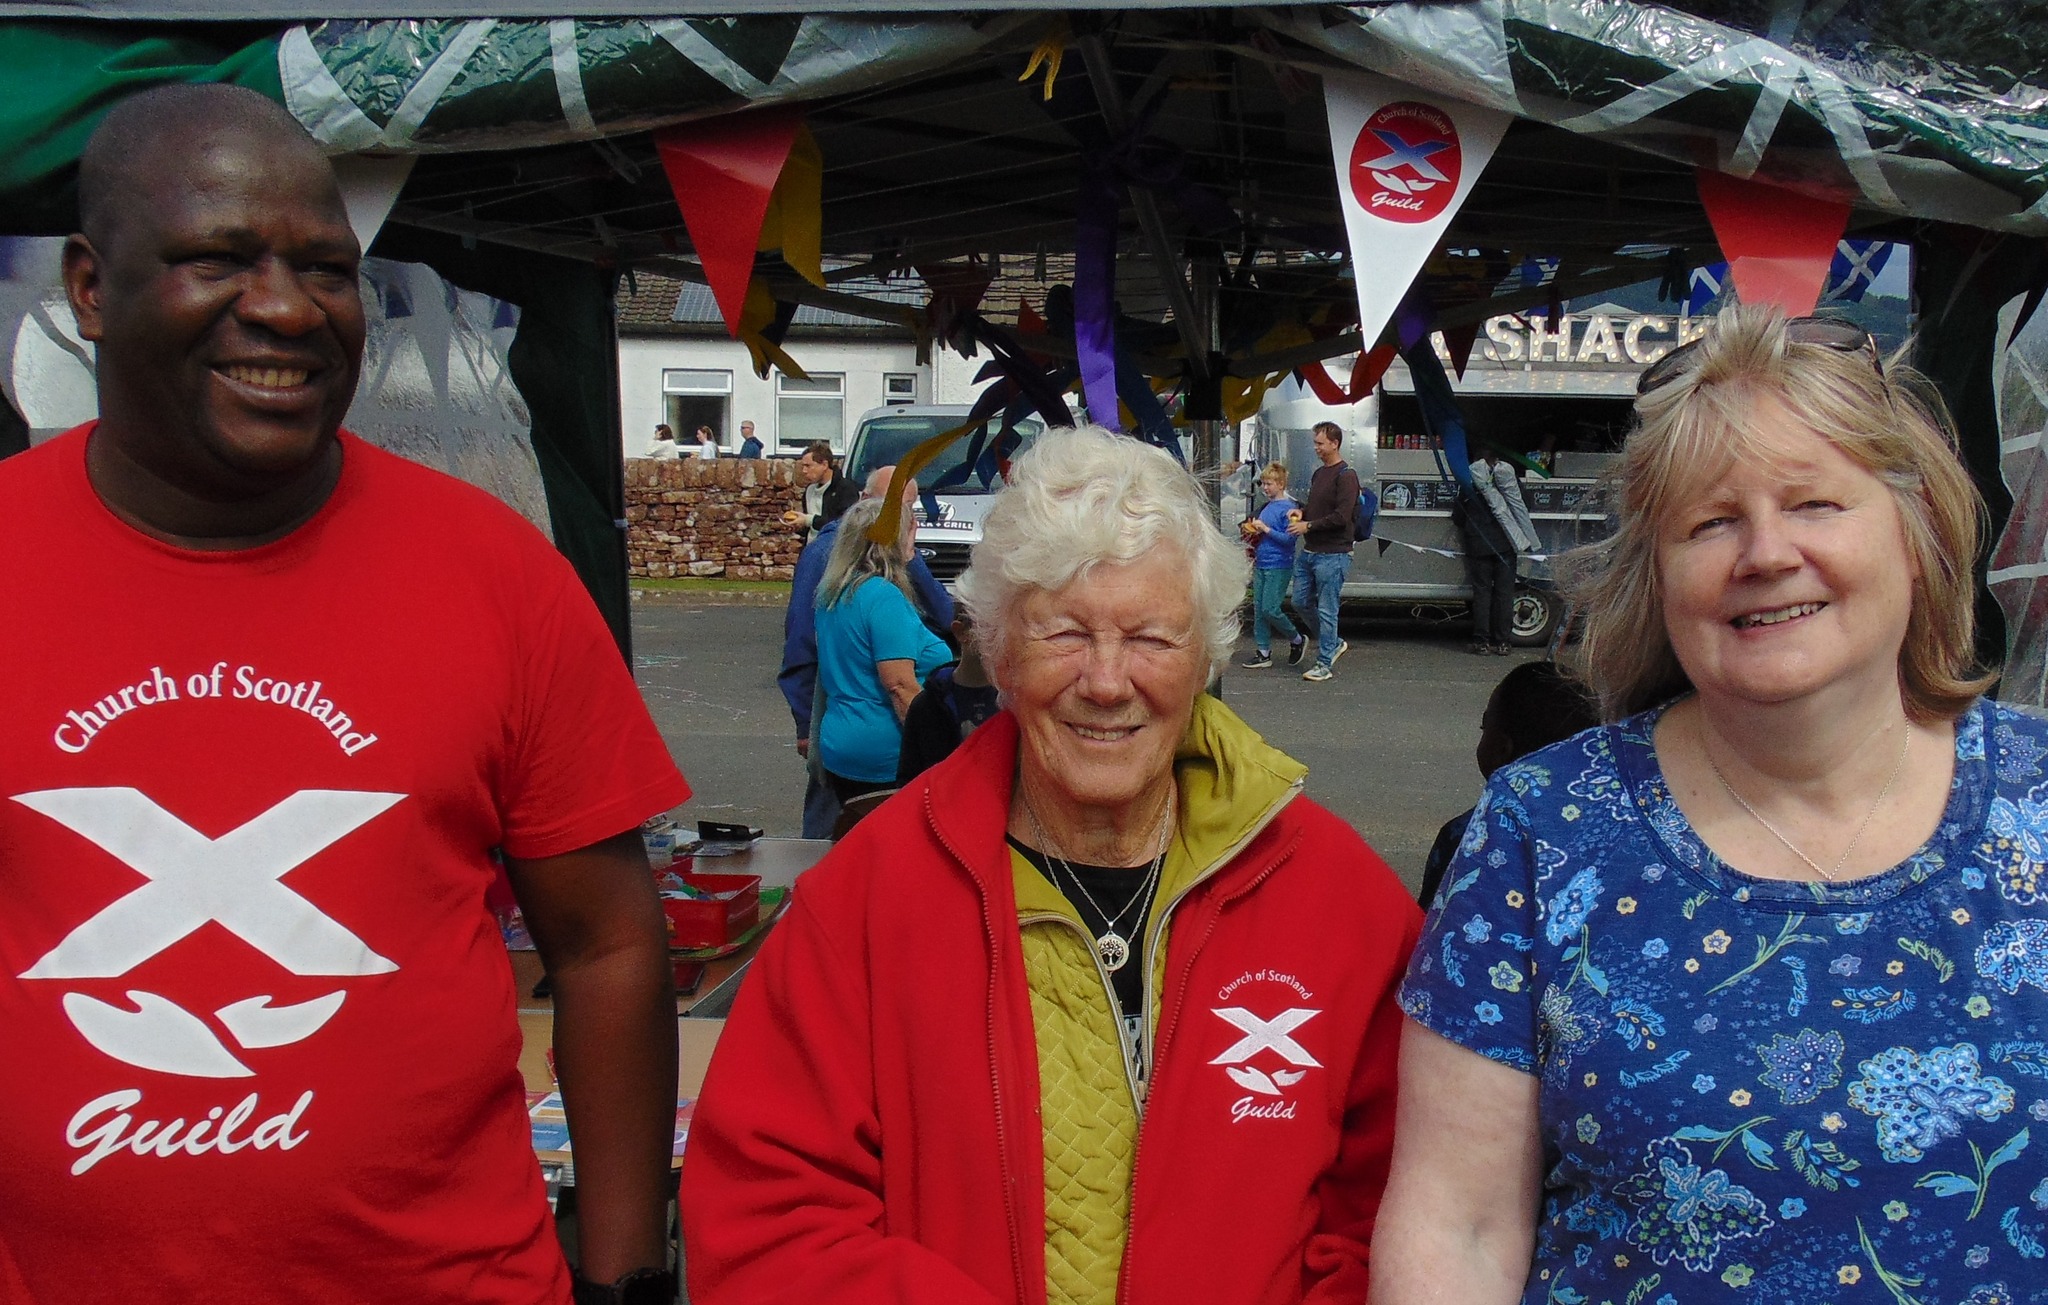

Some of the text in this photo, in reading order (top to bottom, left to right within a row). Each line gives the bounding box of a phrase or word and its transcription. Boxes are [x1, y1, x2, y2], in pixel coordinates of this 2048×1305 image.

[1377, 106, 1451, 136] Church of Scotland
[1371, 192, 1424, 211] Guild
[943, 521, 973, 530] GRILL
[55, 662, 378, 756] Church of Scotland
[1218, 968, 1313, 1000] Church of Scotland
[1231, 1096, 1297, 1123] Guild
[66, 1089, 313, 1175] Guild
